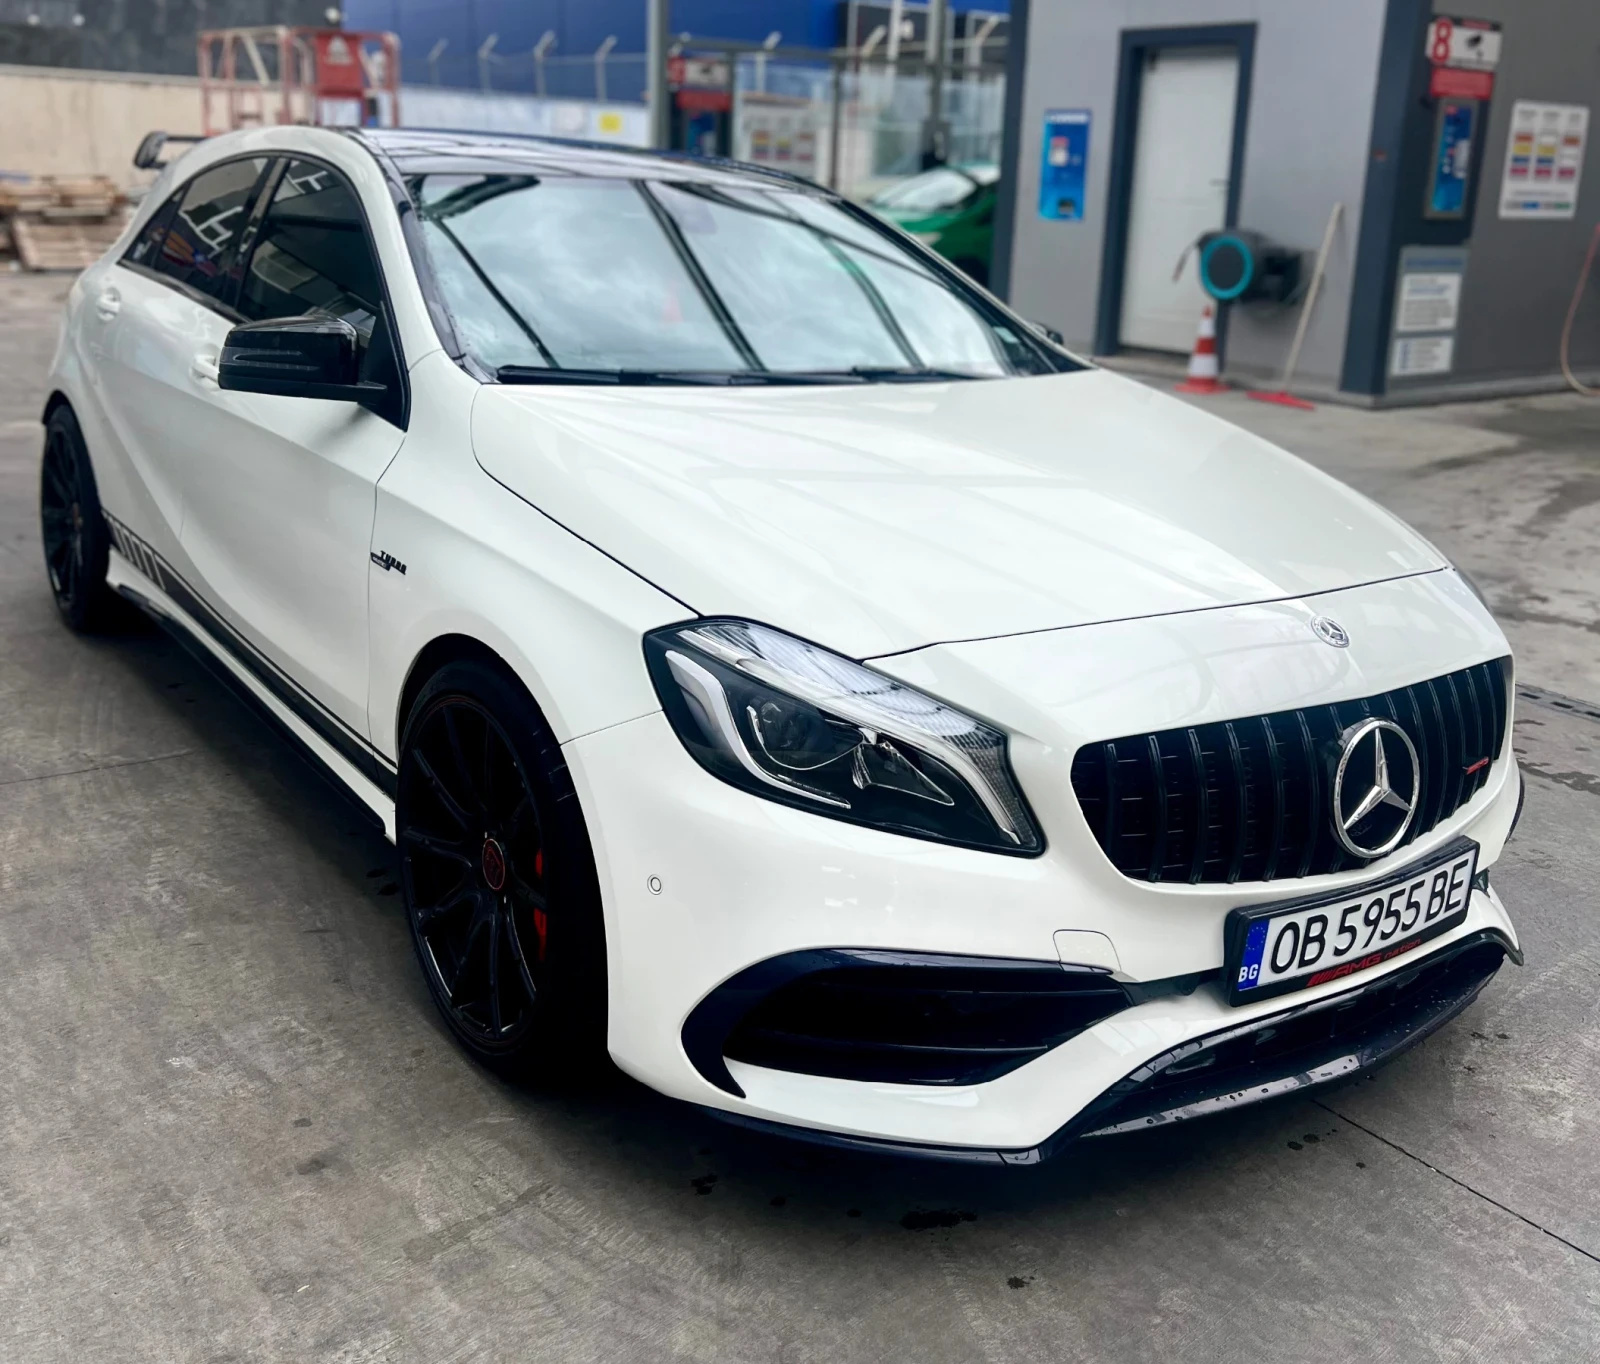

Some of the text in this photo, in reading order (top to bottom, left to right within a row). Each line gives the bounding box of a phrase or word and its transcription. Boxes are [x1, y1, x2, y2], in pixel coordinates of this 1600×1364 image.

[1432, 17, 1452, 64] 8
[1333, 880, 1425, 957] 5955
[1238, 963, 1259, 984] BG
